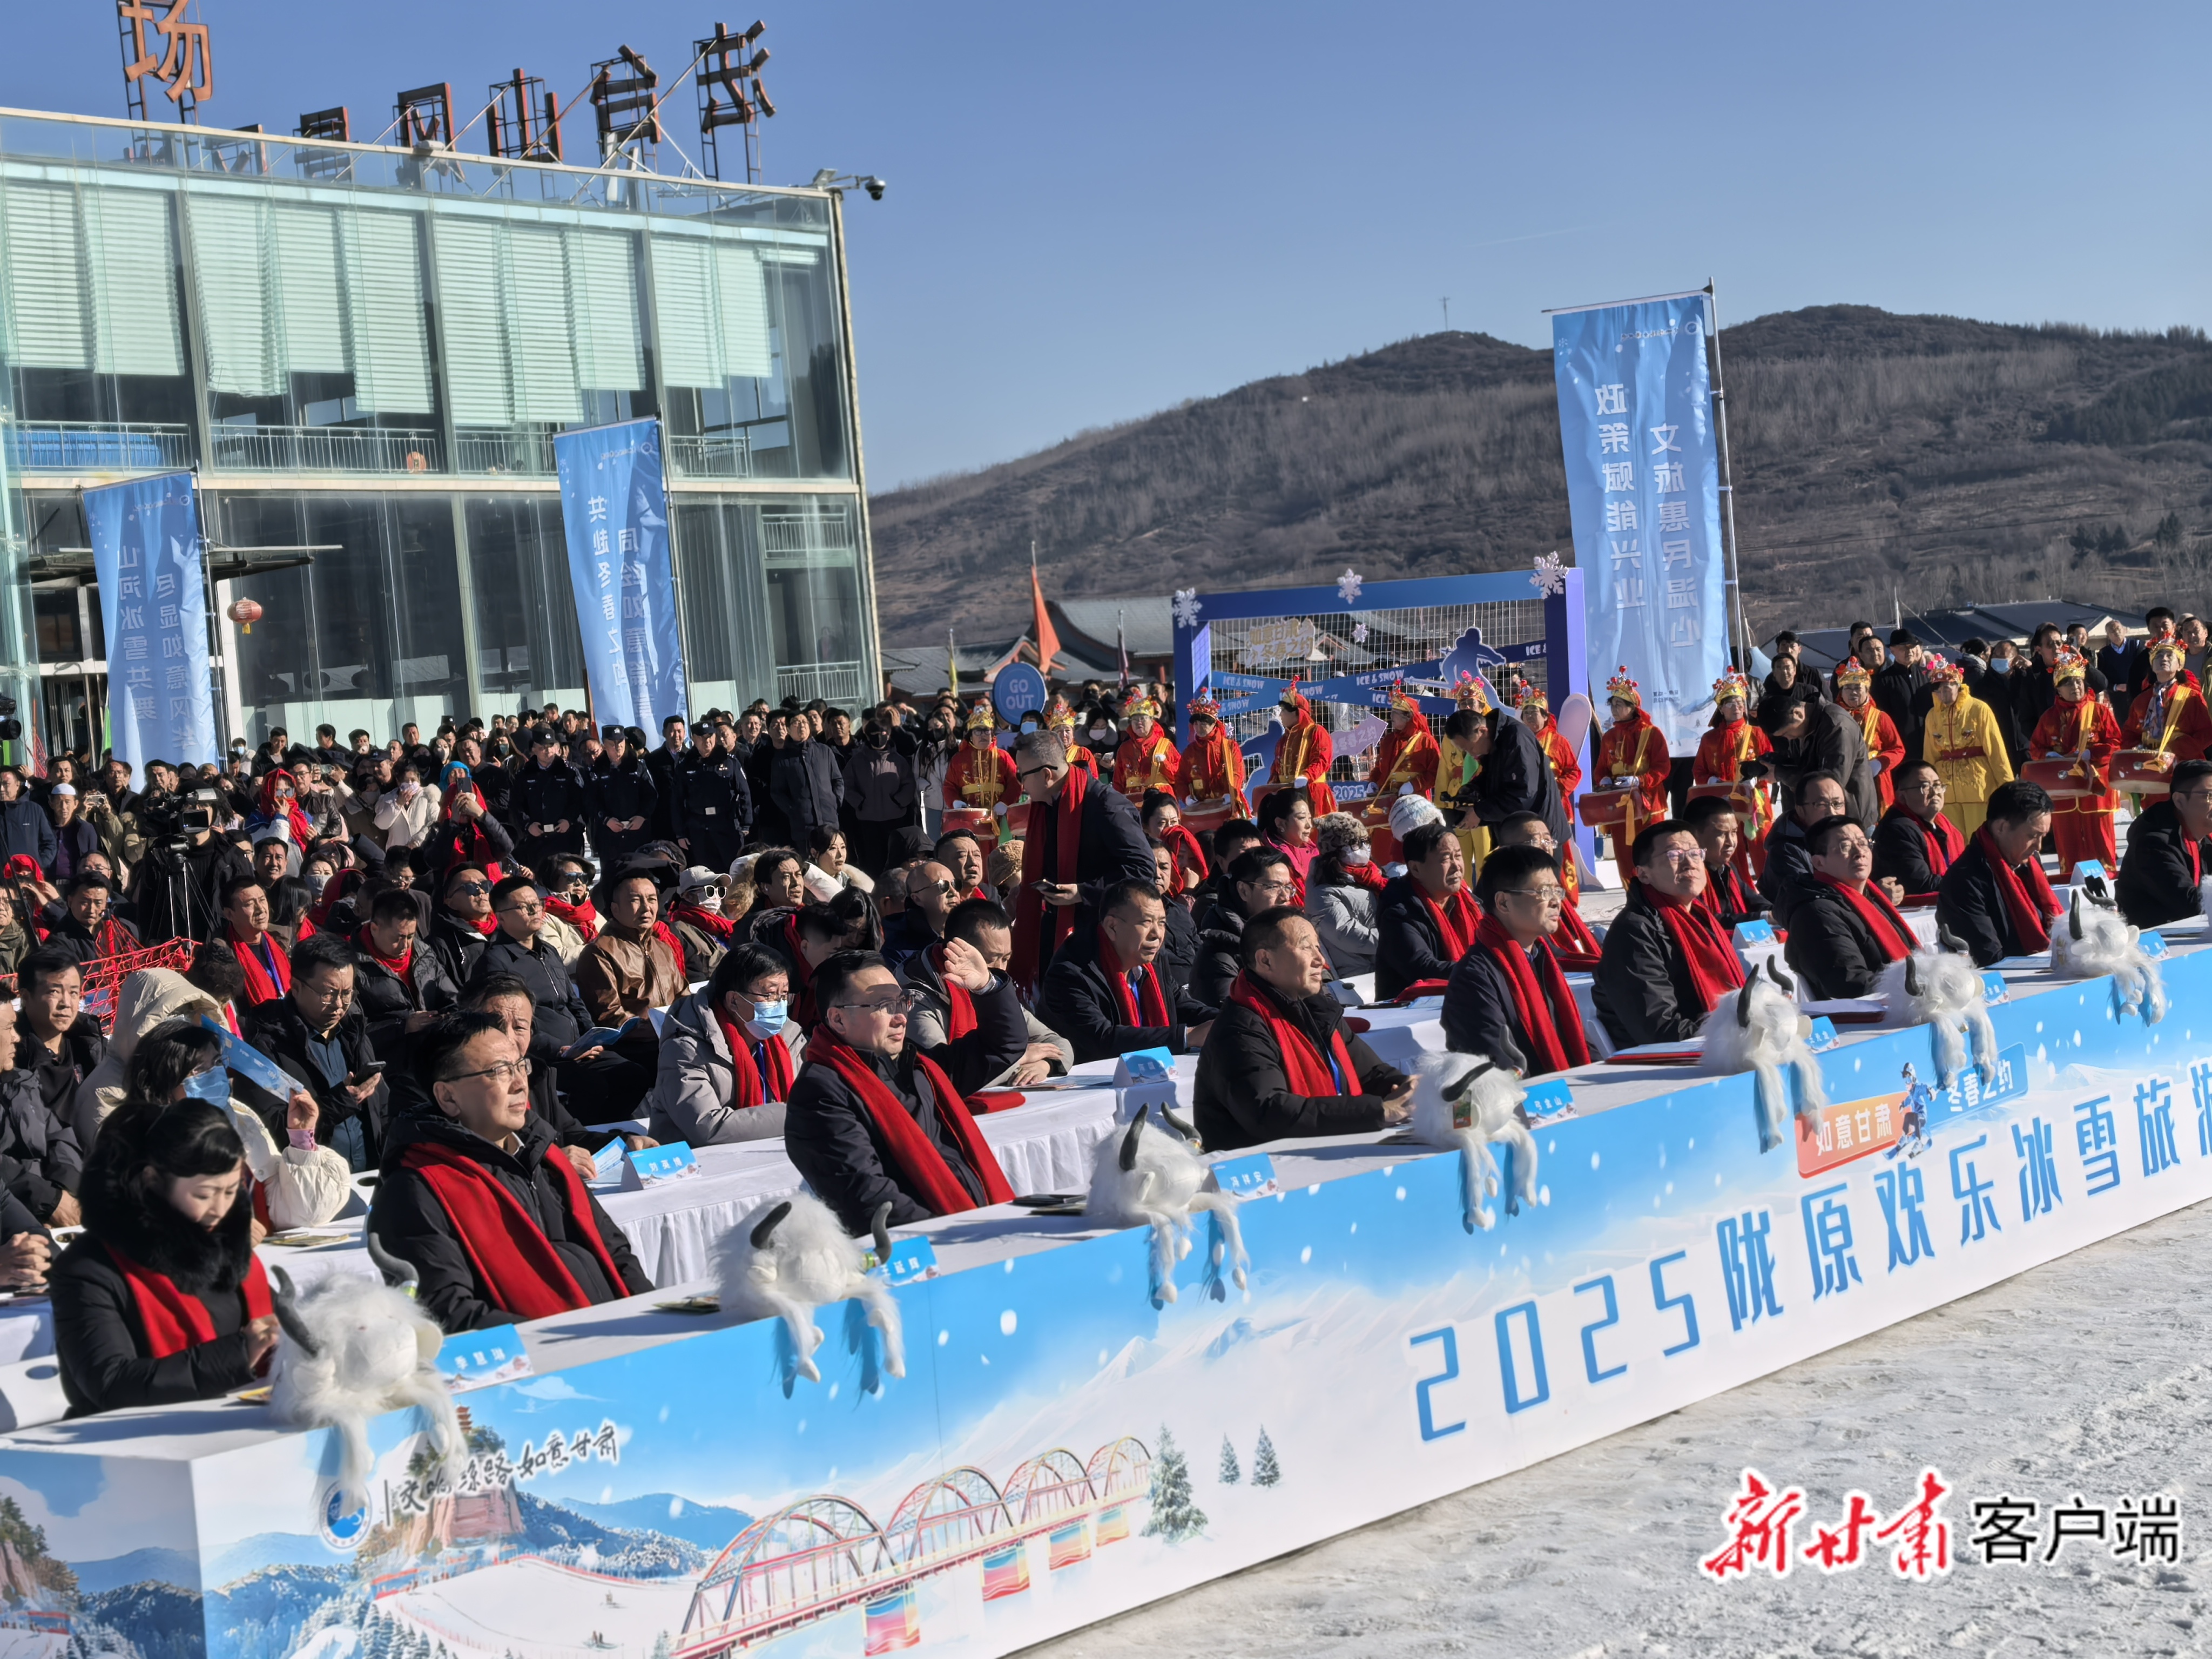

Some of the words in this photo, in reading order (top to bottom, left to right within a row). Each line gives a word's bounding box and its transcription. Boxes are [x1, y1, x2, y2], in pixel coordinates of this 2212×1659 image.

[1526, 644, 1541, 656] ICE
[1223, 676, 1235, 686] ICE
[1243, 678, 1265, 689] SNOW
[1356, 675, 1370, 686] ICE
[1378, 669, 1404, 682] SNOW
[1009, 679, 1028, 693] GO
[1006, 694, 1034, 710] OUT
[1372, 693, 1386, 704] ICE
[1333, 785, 1365, 801] 2025
[1947, 1059, 2014, 1112] 冬春之约
[1816, 1102, 1893, 1157] 如意甘肃
